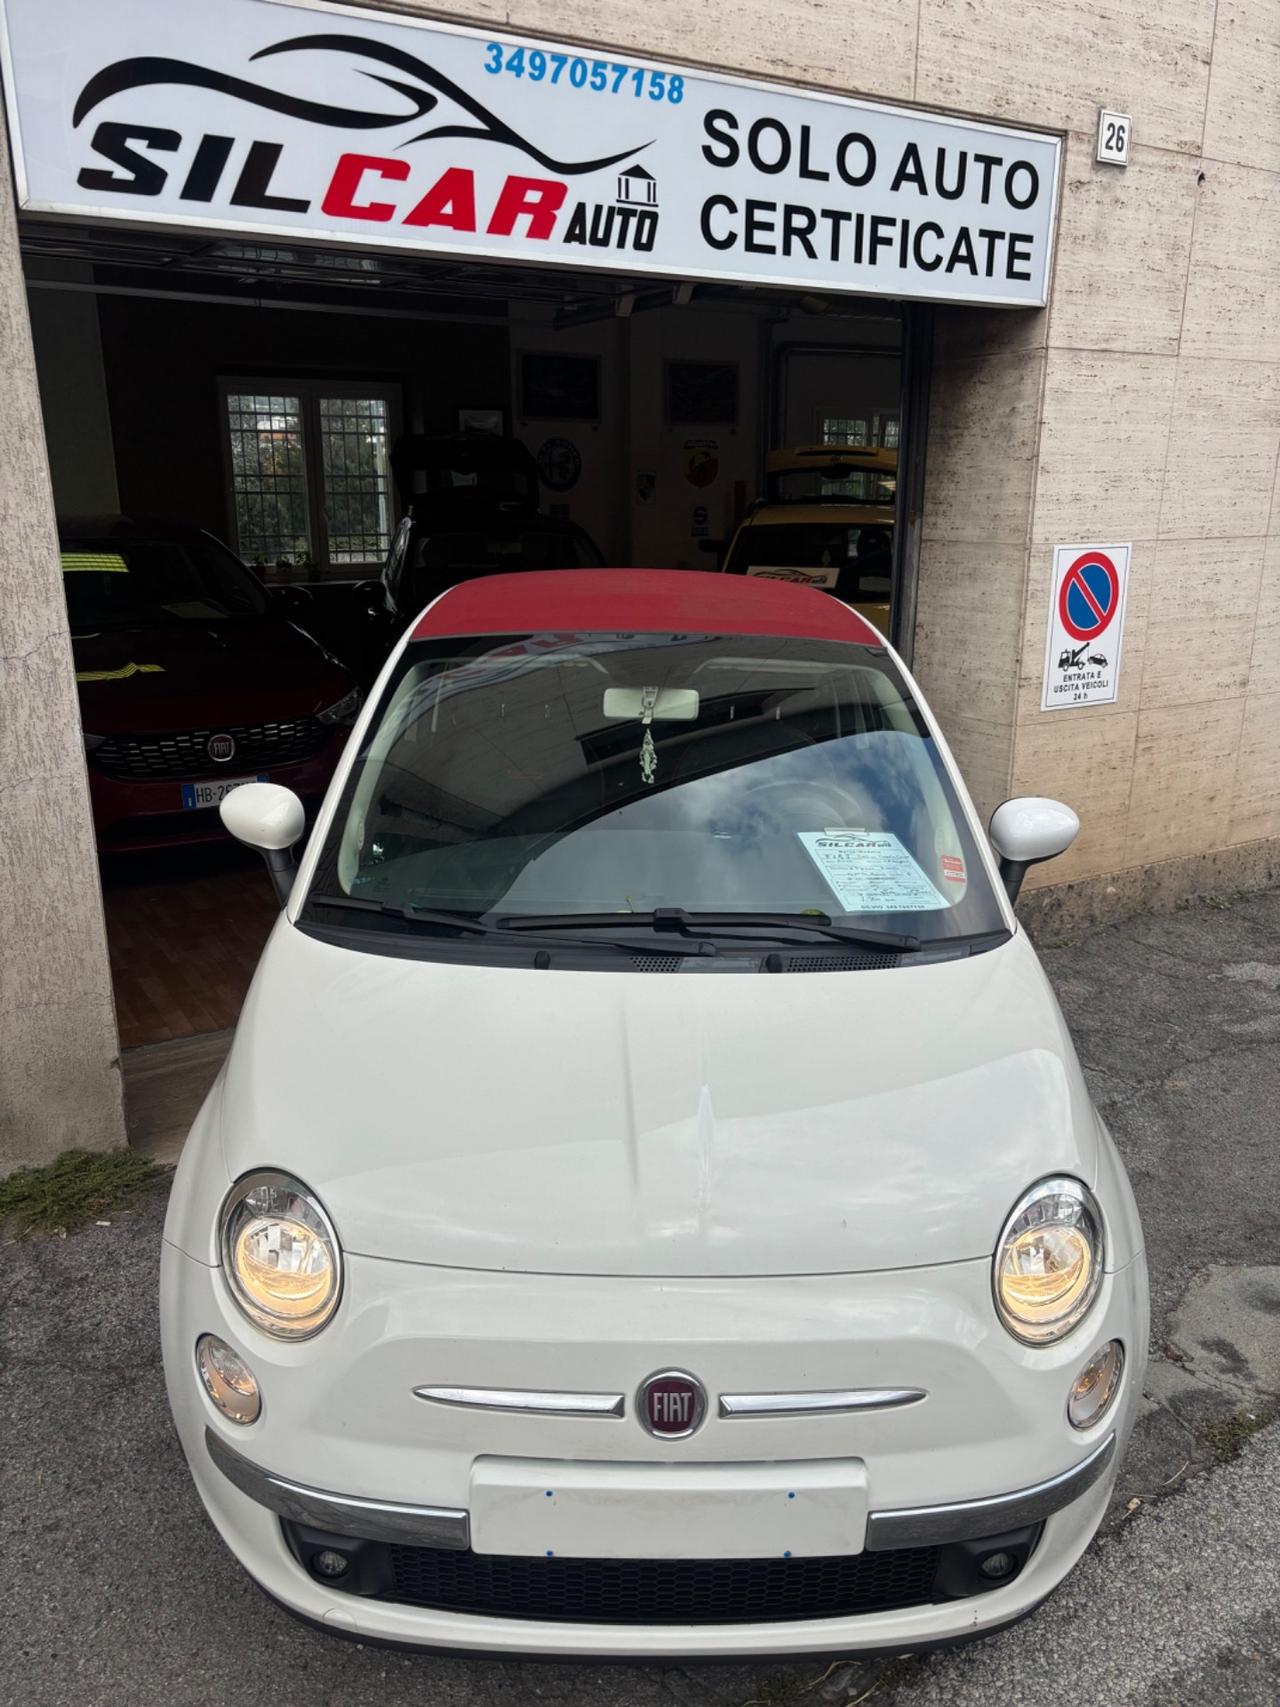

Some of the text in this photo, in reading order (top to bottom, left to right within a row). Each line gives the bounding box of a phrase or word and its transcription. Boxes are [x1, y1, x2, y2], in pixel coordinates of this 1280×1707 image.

[484, 42, 685, 106] 3497057158
[1106, 122, 1126, 153] 26
[701, 108, 1040, 211] SOLO AUTO
[76, 121, 660, 253] SILCAR AUTO
[700, 194, 1035, 282] CERTIFICATE
[1054, 680, 1108, 693] USCITA VEICOLI
[1063, 671, 1102, 683] ENTRATA E
[1073, 692, 1081, 701] 24
[213, 742, 230, 755] FIAT
[652, 1393, 692, 1422] FIAT
